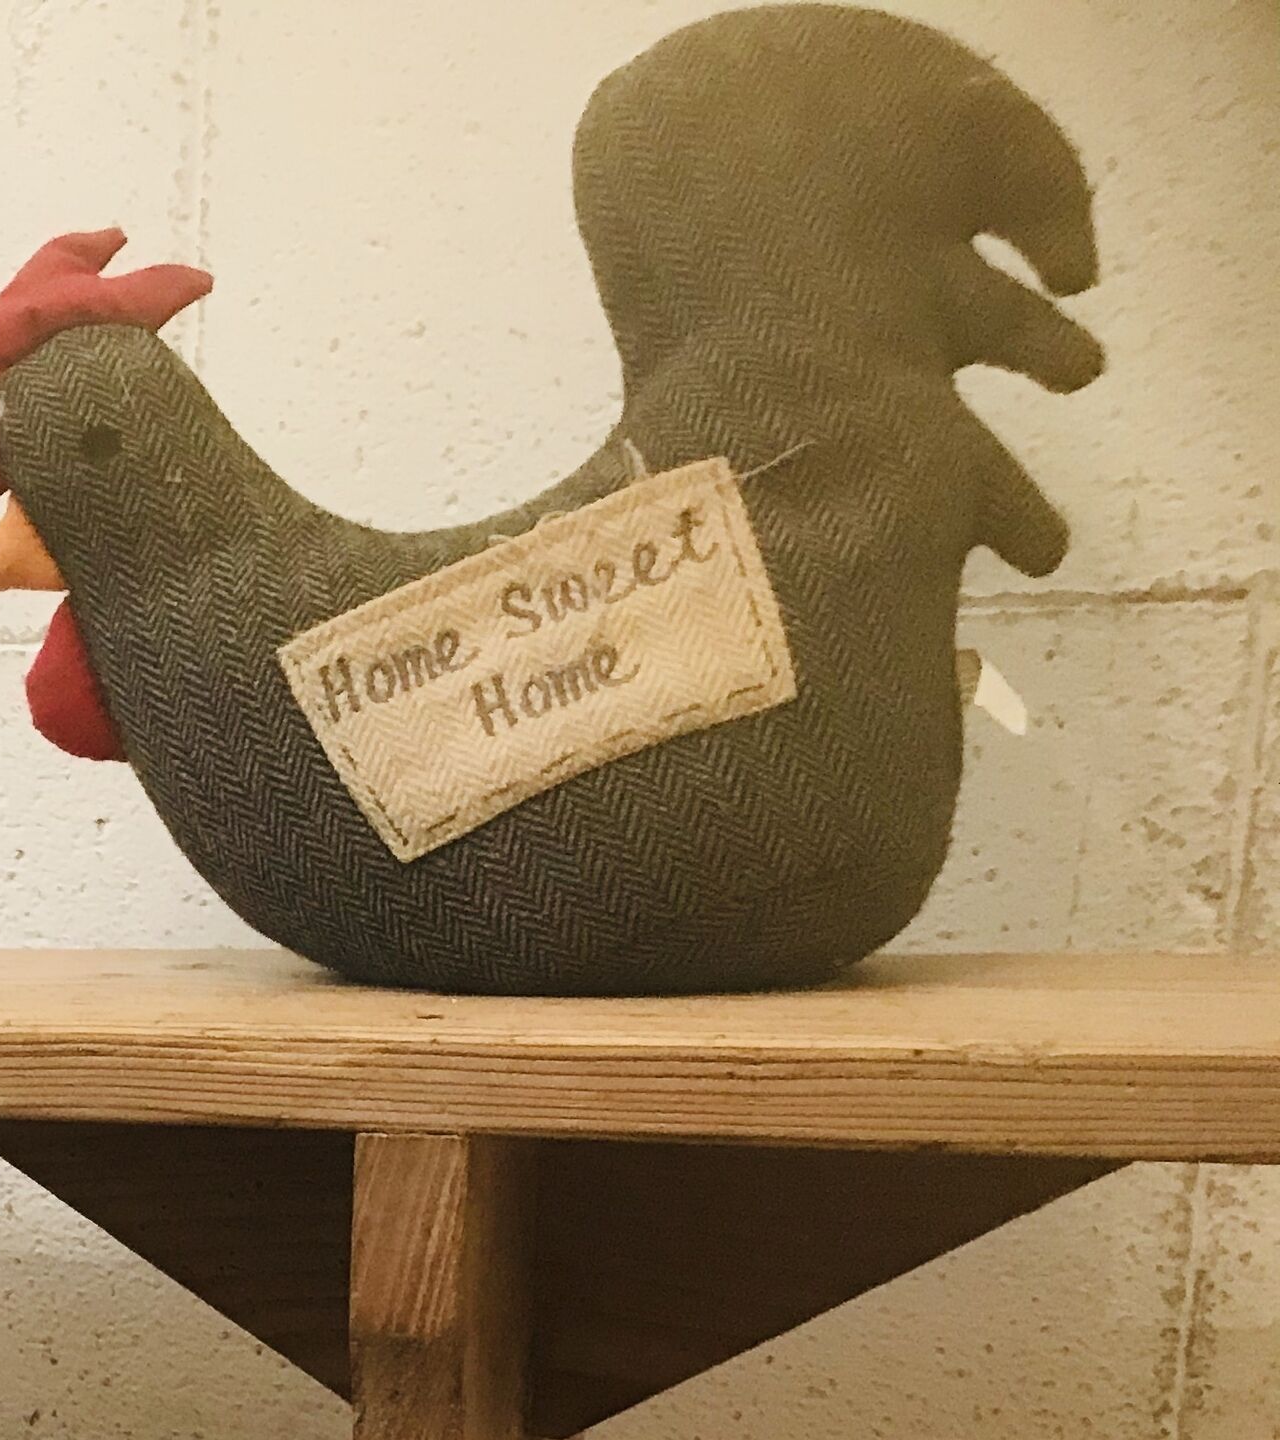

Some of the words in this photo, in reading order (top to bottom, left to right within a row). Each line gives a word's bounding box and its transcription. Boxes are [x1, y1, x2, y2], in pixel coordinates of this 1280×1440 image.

[317, 627, 482, 723] Home
[498, 505, 720, 641] Sweet
[469, 643, 640, 738] Home
